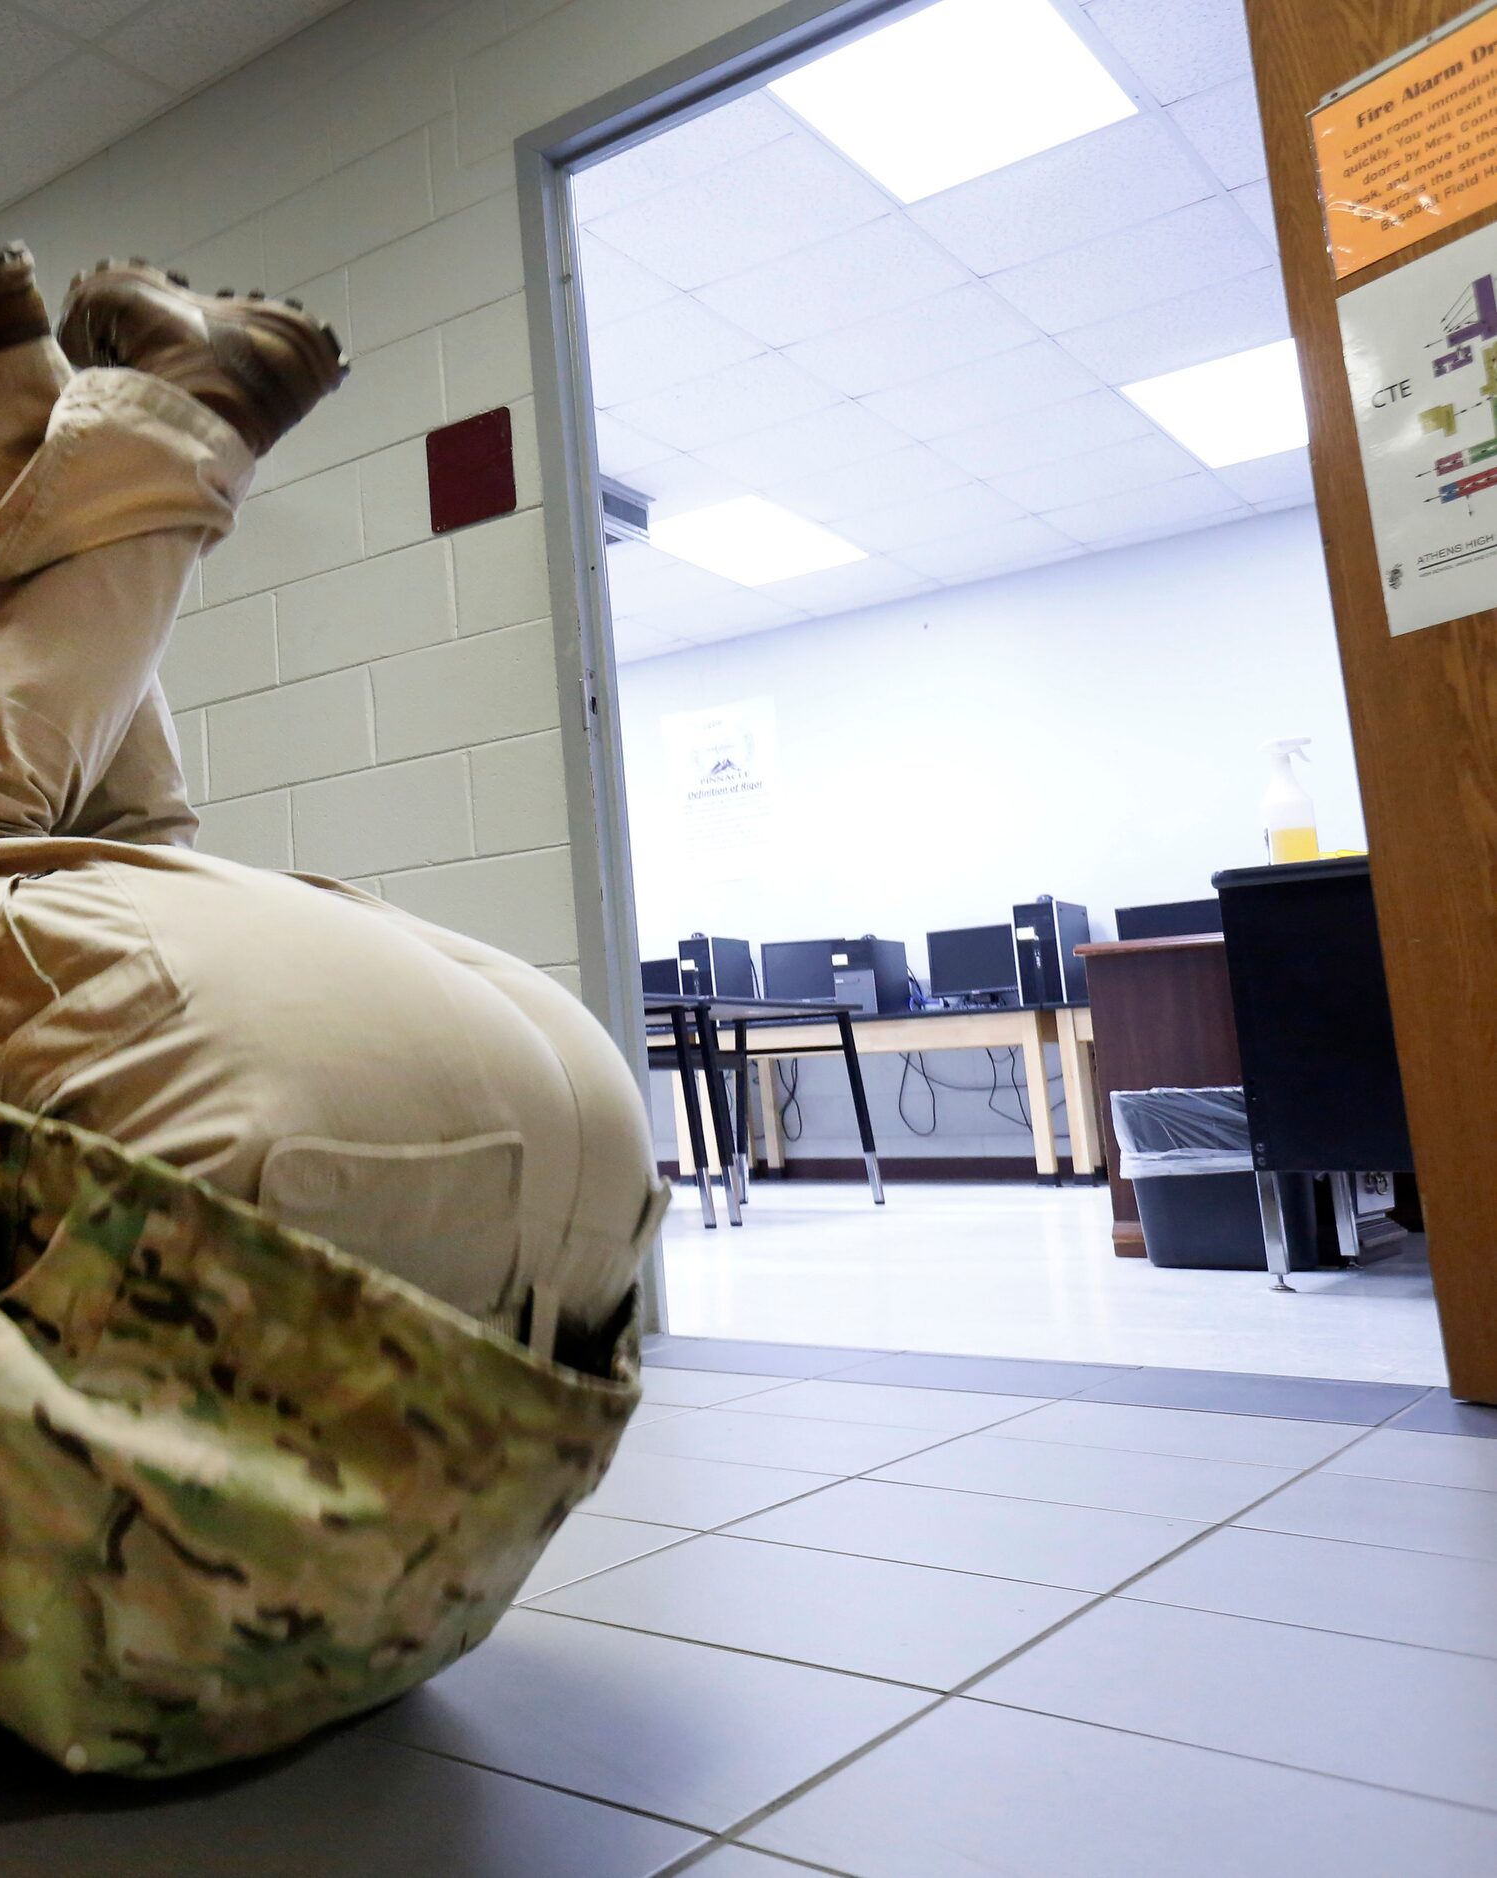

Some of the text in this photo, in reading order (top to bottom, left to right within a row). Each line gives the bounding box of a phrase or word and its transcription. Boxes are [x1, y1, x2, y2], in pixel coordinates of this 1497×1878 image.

[1343, 69, 1497, 159] Leave room immediat
[1357, 101, 1394, 129] Fire
[1402, 61, 1463, 103] Alarm
[1396, 131, 1421, 149] You
[1426, 111, 1451, 132] will
[1456, 95, 1482, 116] exit
[1362, 160, 1401, 185] doors
[1404, 149, 1420, 163] by
[1424, 132, 1454, 152] Mrs.
[1381, 184, 1427, 212] across
[1431, 170, 1453, 186] the
[1458, 146, 1497, 172] stree
[1386, 170, 1410, 191] and
[1414, 151, 1451, 176] move
[1457, 141, 1470, 154] to
[1444, 173, 1479, 199] Field
[1372, 378, 1413, 408] CTE
[1417, 543, 1462, 564] ATHENS
[1465, 533, 1494, 550] HIGH
[688, 786, 728, 801] Definition
[730, 783, 739, 794] of
